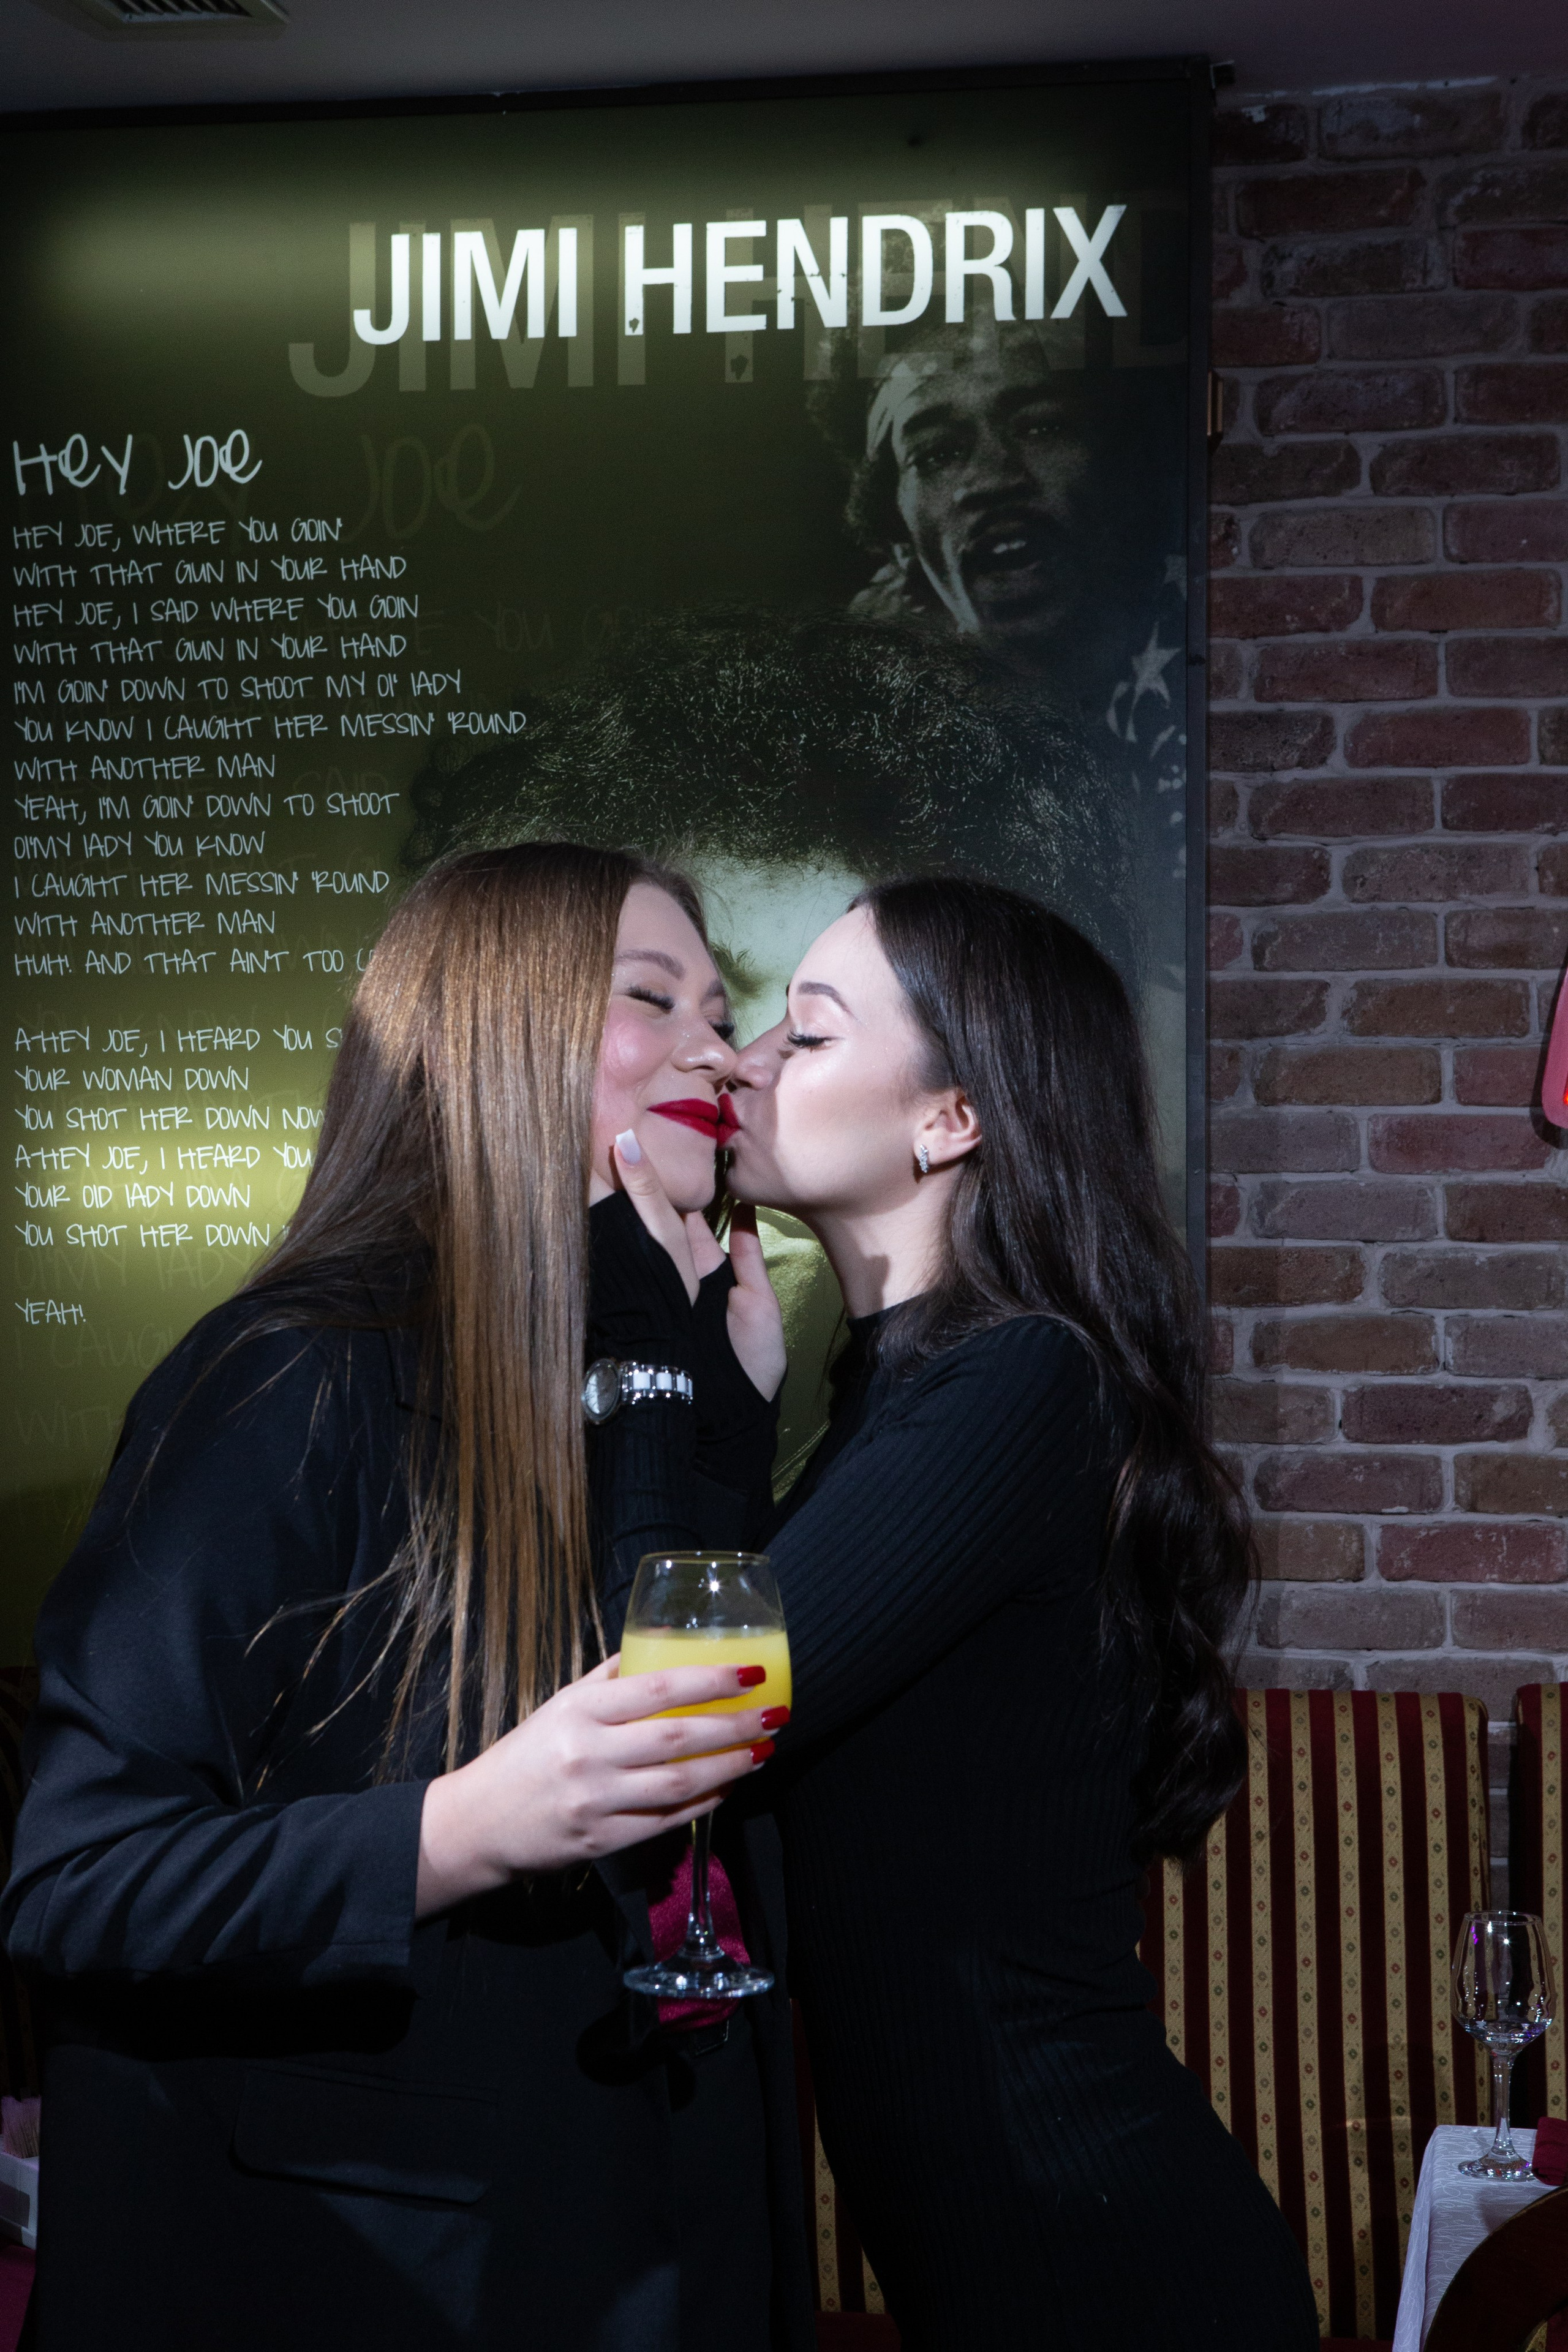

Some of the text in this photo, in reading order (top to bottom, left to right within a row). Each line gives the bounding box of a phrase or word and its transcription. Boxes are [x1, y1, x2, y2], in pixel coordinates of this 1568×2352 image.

[353, 204, 1128, 345] JIMI HENDRIX
[13, 521, 63, 549] HEY
[75, 523, 121, 552] JOE,
[132, 520, 226, 546] WHERE
[238, 516, 279, 544] YOU
[13, 554, 407, 588] WITH THAT GUN IN YOUR HAND
[13, 598, 63, 628] HEY
[75, 601, 121, 631] JOE,
[132, 601, 138, 625] I
[149, 597, 199, 624] SAID
[210, 597, 304, 623] WHERE
[317, 593, 358, 620] YOU
[13, 632, 407, 665] WITH THAT GUN IN YOUR HAND
[120, 676, 186, 703] DOWN
[197, 677, 229, 701] TO
[240, 676, 314, 701] SHOOT
[325, 670, 366, 699] MY
[13, 716, 53, 743] YOU
[65, 715, 135, 743] KNOW
[146, 718, 153, 742] I
[164, 714, 262, 741] CAUGHT
[274, 714, 328, 739] HER
[13, 752, 276, 782] WITH ANOTHER MAN
[14, 794, 87, 826] YEAH,
[206, 791, 271, 818] DOWN
[282, 793, 315, 817] TO
[326, 792, 401, 816] SHOOT
[143, 831, 184, 858] YOU
[195, 830, 266, 858] KNOW
[13, 876, 20, 899] I
[31, 872, 128, 898] CAUGHT
[140, 872, 194, 897] HER
[13, 908, 276, 938] WITH ANOTHER MAN
[13, 952, 72, 977] HUH!
[85, 949, 132, 975] AND
[143, 948, 217, 975] THAT
[302, 949, 344, 973] TOO
[102, 1028, 148, 1058] JOE,
[159, 1029, 166, 1053] I
[177, 1025, 261, 1053] HEARD
[273, 1023, 313, 1052] YOU
[14, 1065, 249, 1092] YOUR WOMAN DOWN
[14, 1104, 54, 1131] YOU
[65, 1106, 128, 1131] SHOT
[139, 1106, 194, 1131] HER
[205, 1104, 270, 1131] DOWN
[102, 1145, 148, 1175] JOE,
[159, 1146, 166, 1170] I
[176, 1143, 261, 1170] HEARD
[272, 1141, 314, 1170] YOU
[14, 1181, 71, 1209] YOUR
[186, 1182, 251, 1209] DOWN
[14, 1220, 54, 1247] YOU
[66, 1223, 128, 1248] SHOT
[139, 1223, 194, 1248] HER
[205, 1221, 271, 1248] DOWN
[14, 1297, 87, 1325] YEAH!
